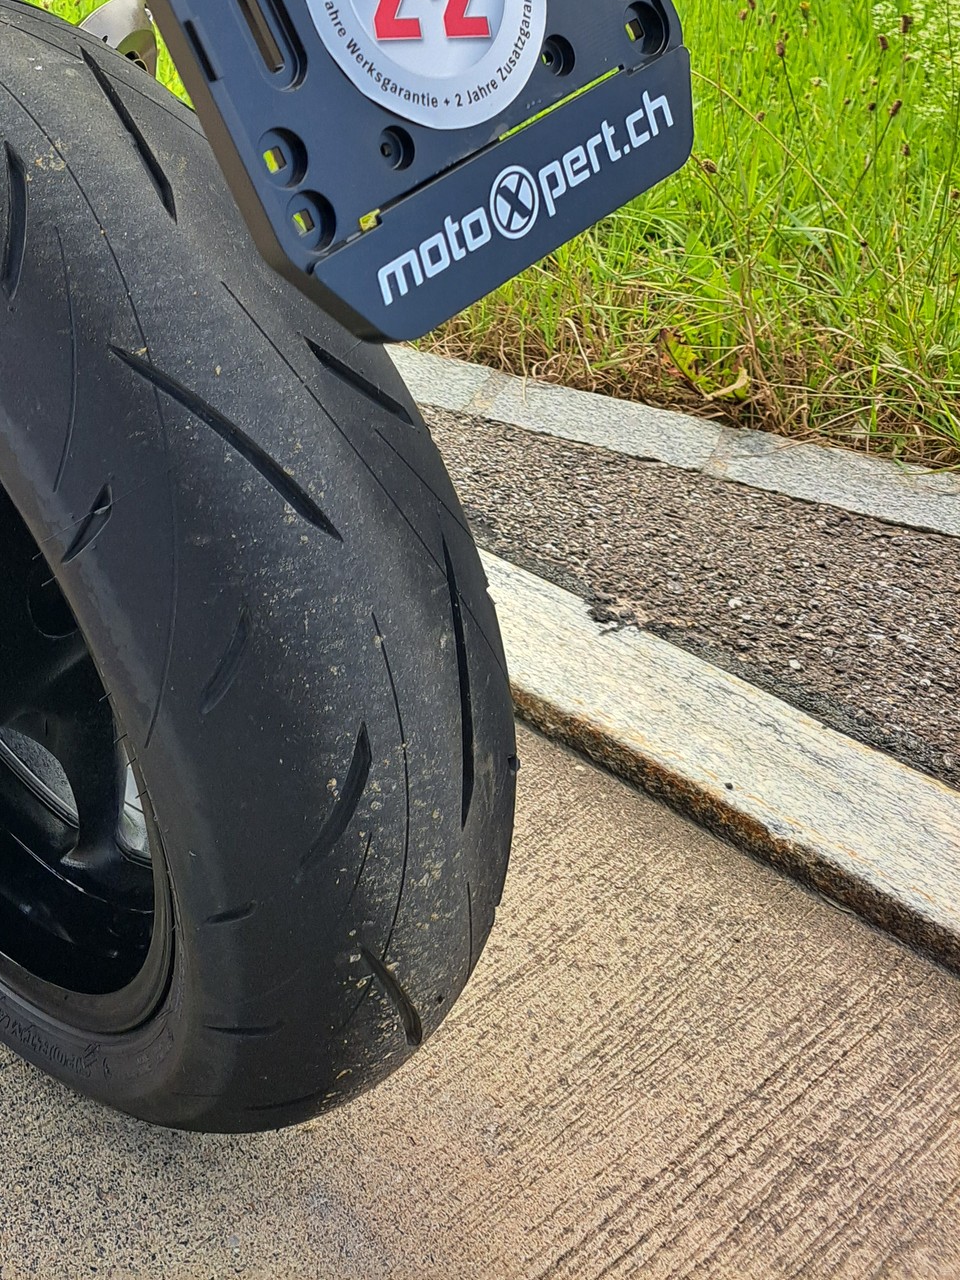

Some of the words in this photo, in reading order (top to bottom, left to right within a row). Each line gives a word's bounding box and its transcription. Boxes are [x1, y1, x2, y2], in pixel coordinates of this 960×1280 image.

[346, 37, 439, 108] Werksgarantie
[454, 93, 464, 107] 2
[467, 78, 499, 105] Jahre
